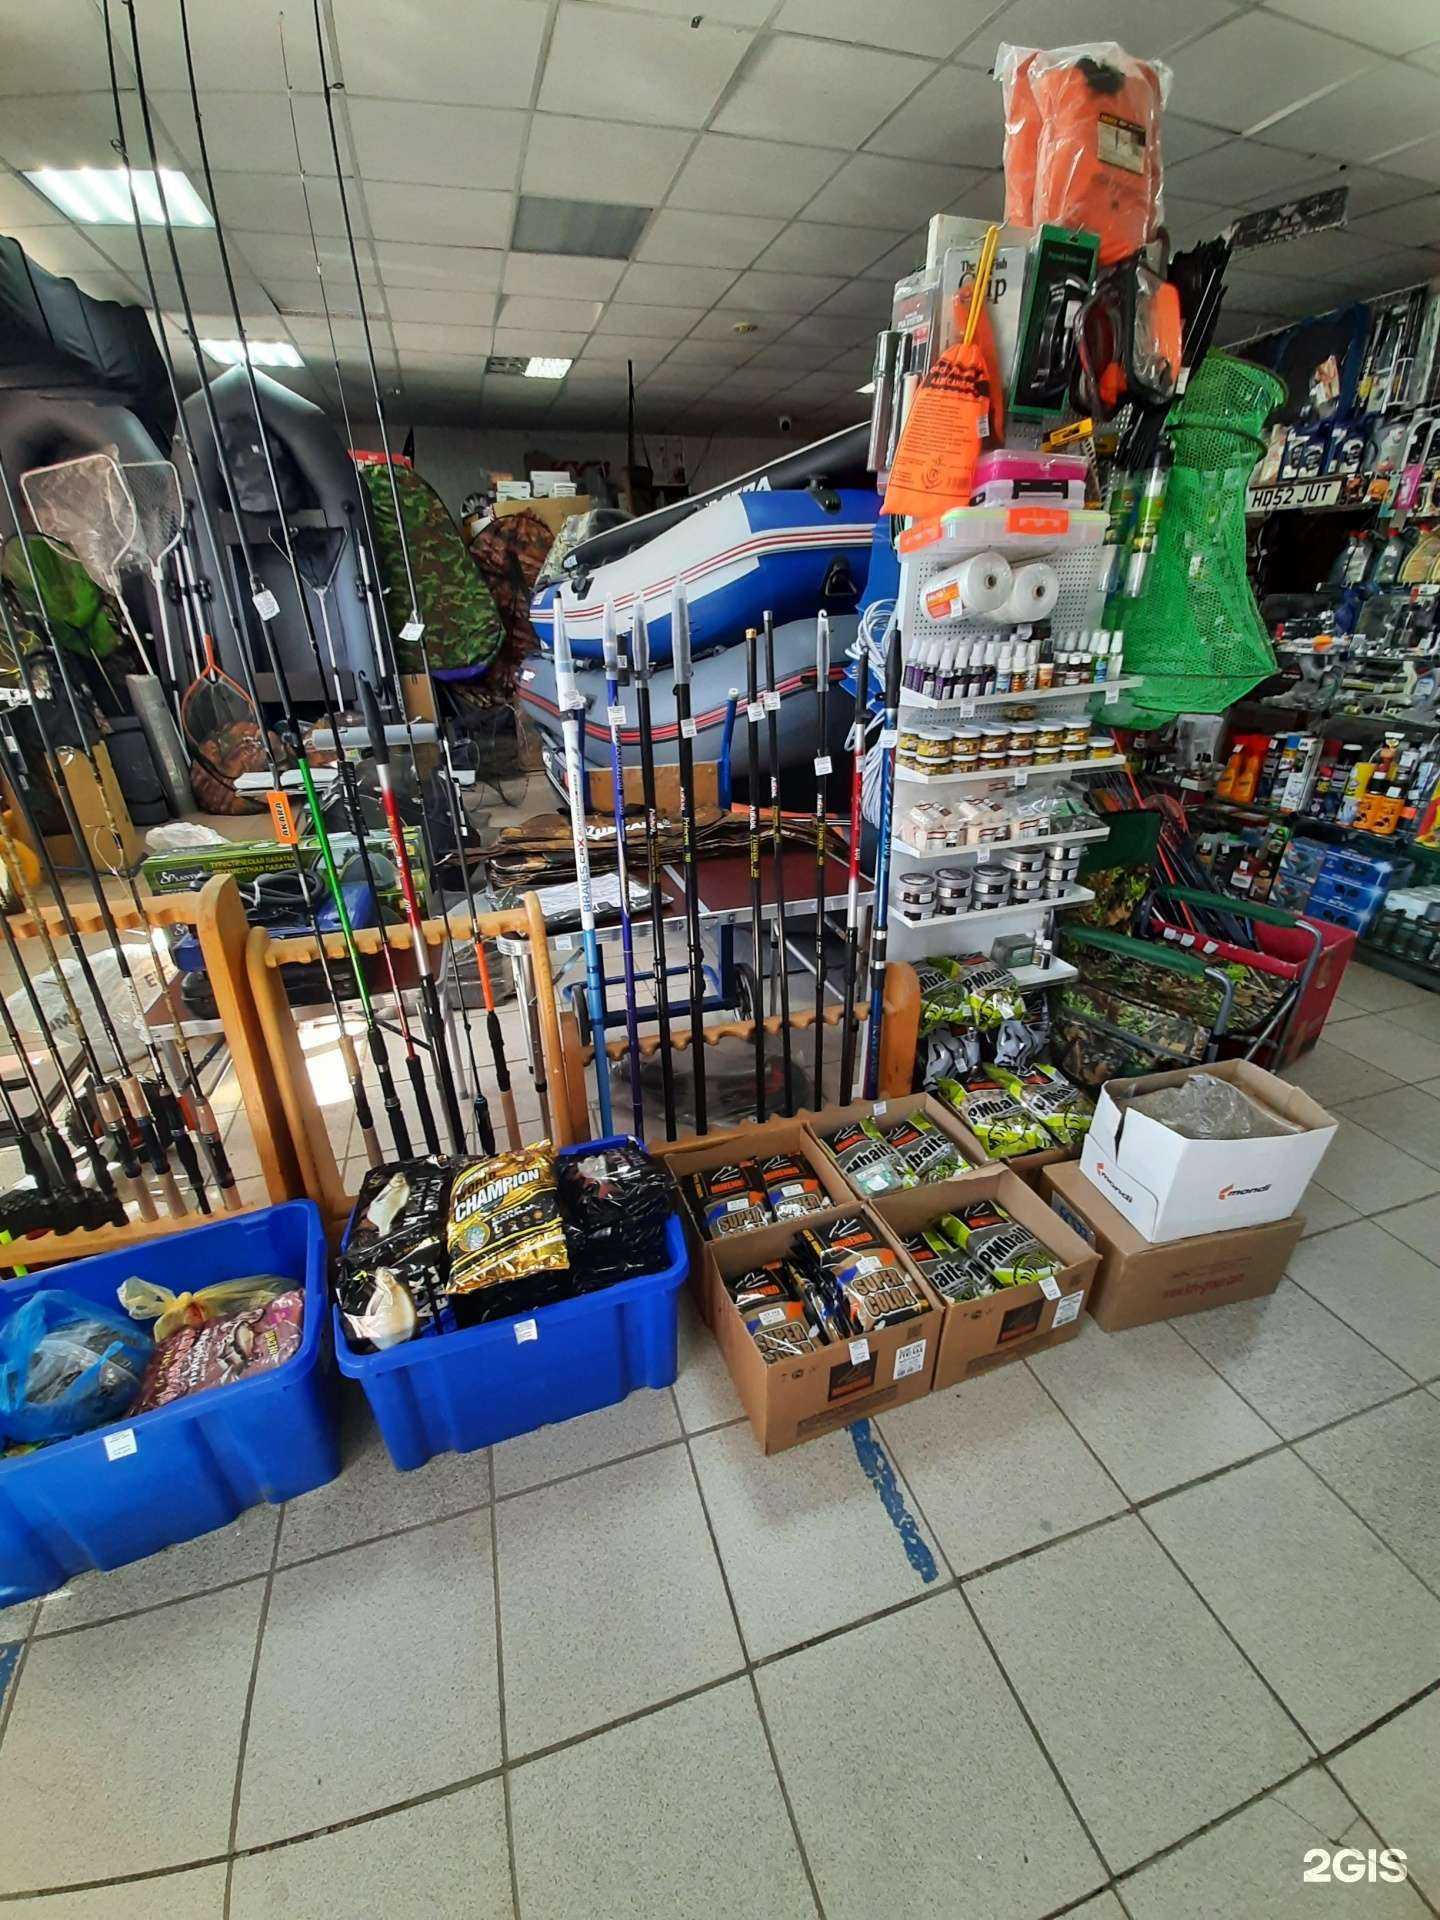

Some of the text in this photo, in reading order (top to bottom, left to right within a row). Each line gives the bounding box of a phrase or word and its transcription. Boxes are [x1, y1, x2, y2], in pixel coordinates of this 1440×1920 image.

[1296, 483, 1332, 502] JUT
[276, 802, 290, 836] AKARA
[967, 1094, 1019, 1122] PMbai
[454, 1168, 540, 1223] CHAMPION
[1226, 1183, 1273, 1197] mondi
[980, 1226, 1034, 1270] PMbait
[852, 1269, 905, 1297] SUPER
[863, 1290, 918, 1318] COLOR
